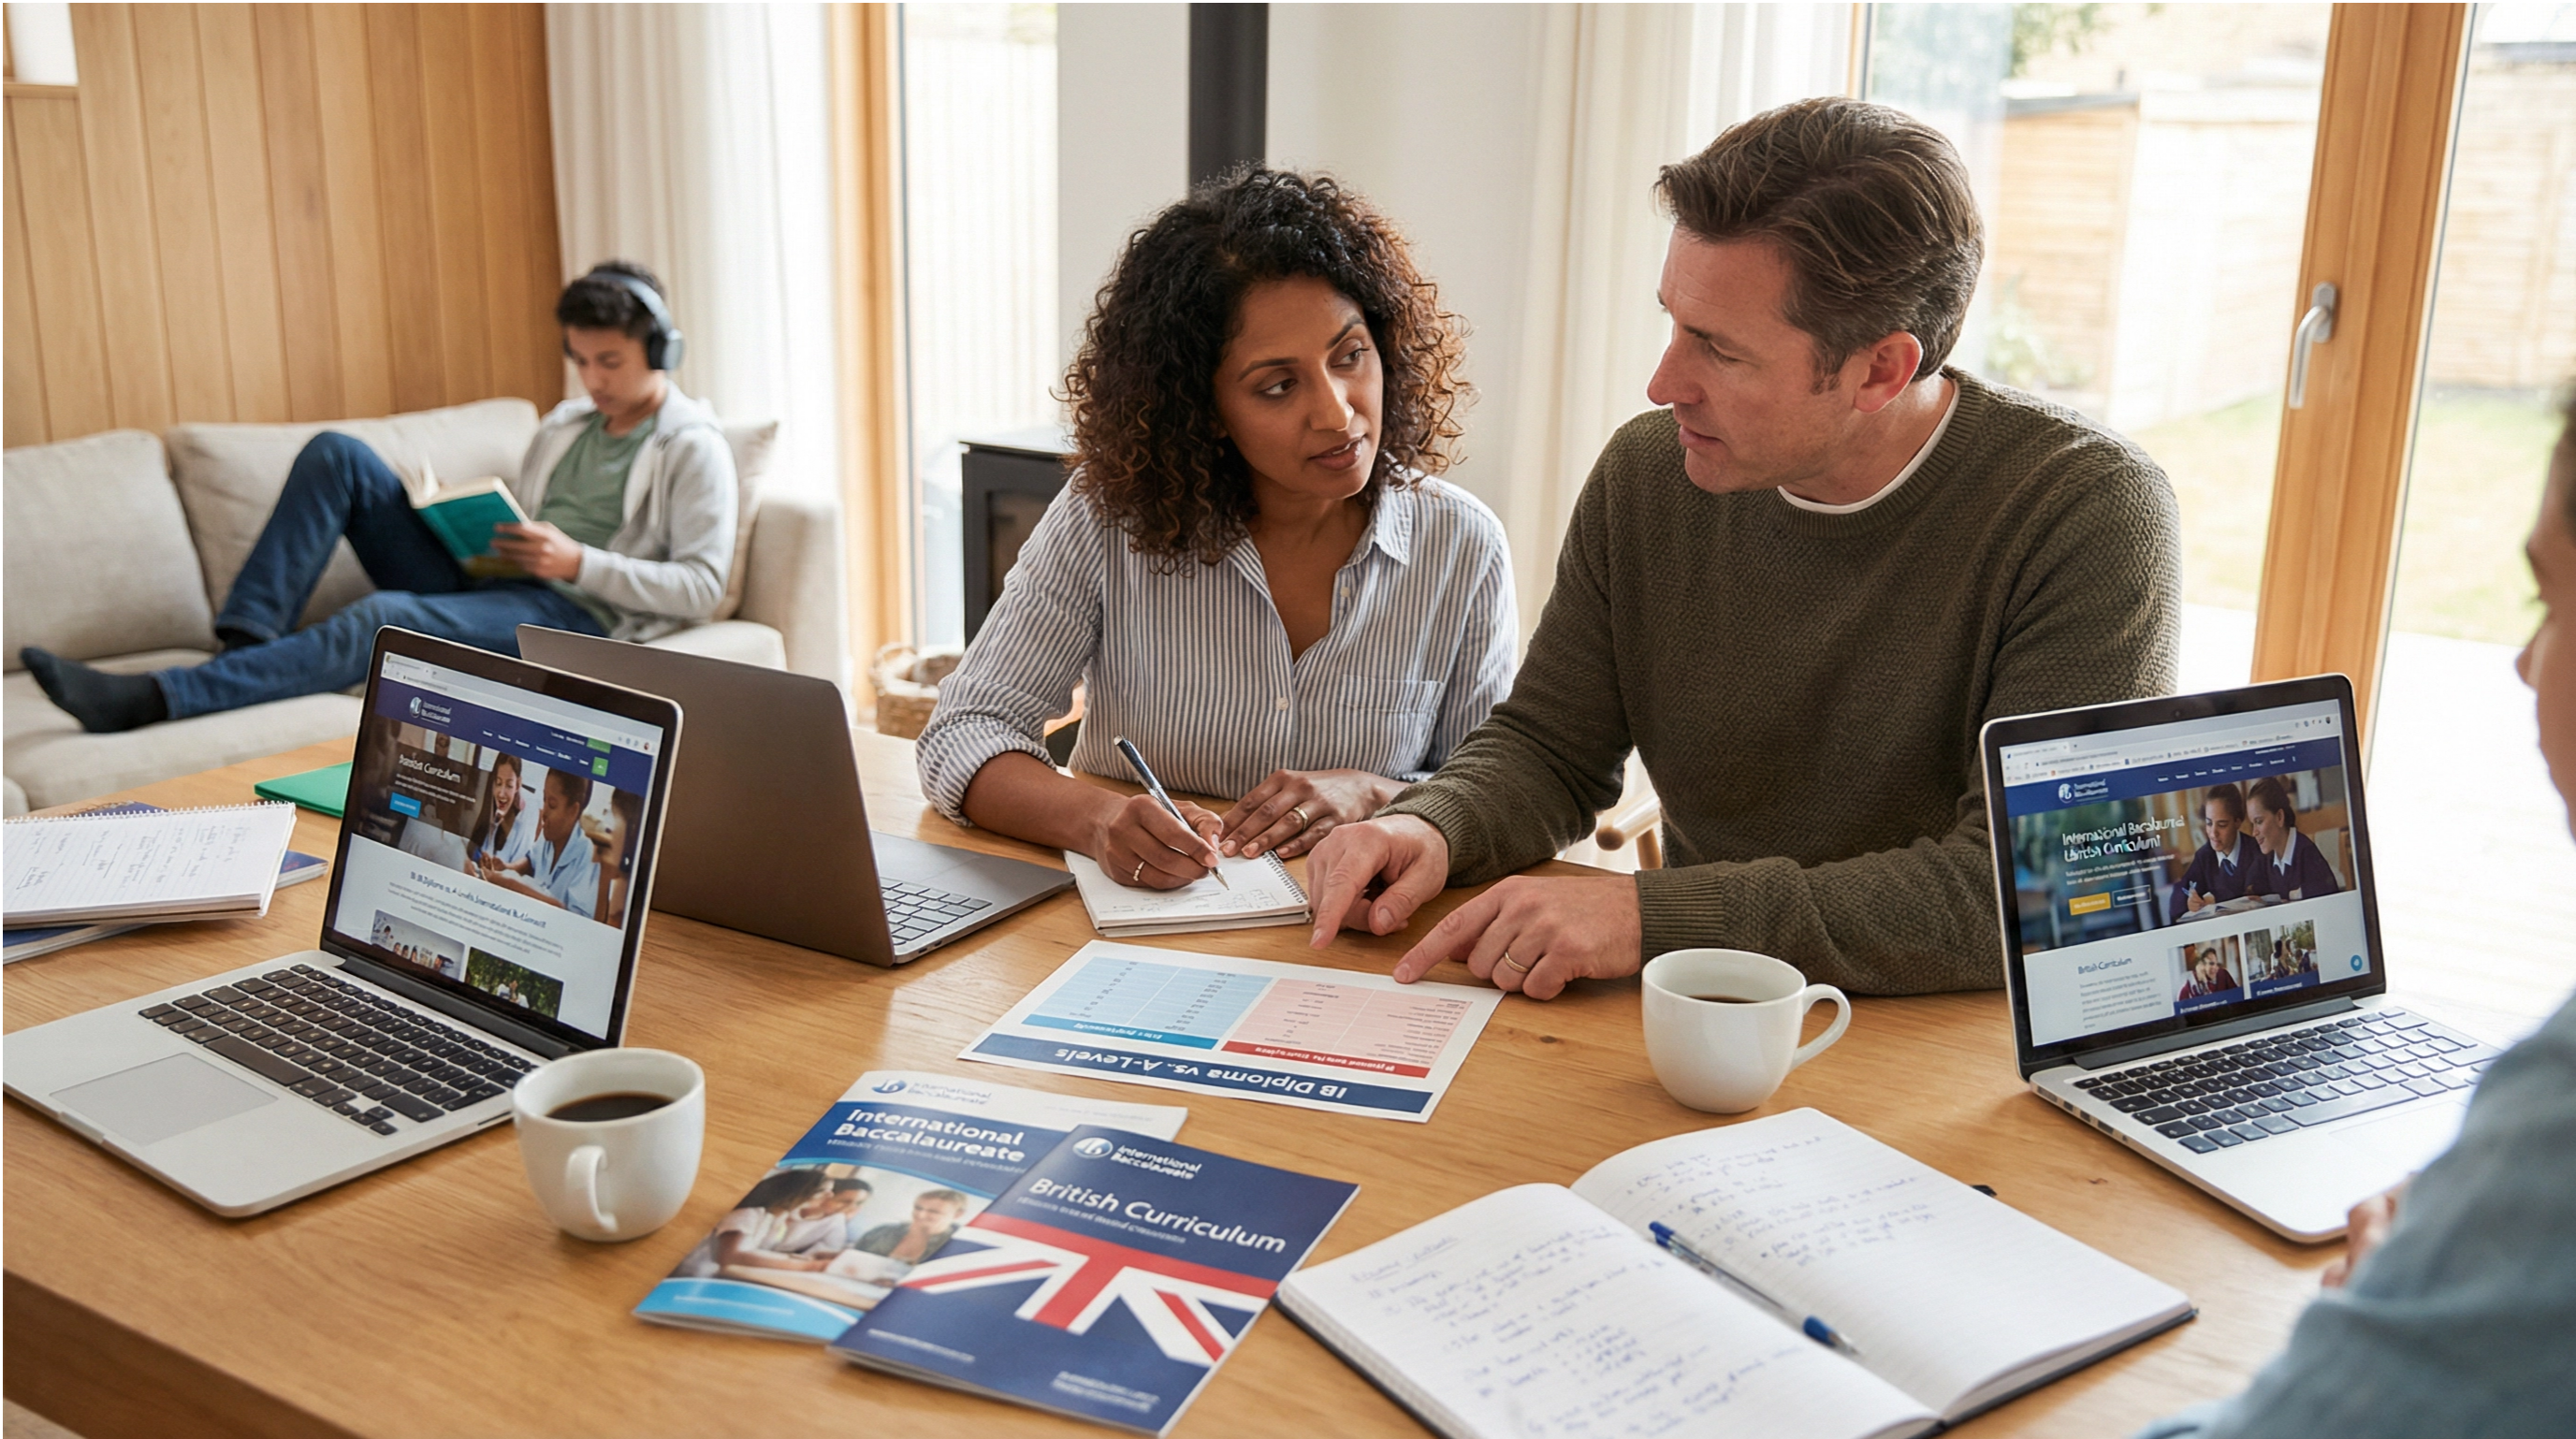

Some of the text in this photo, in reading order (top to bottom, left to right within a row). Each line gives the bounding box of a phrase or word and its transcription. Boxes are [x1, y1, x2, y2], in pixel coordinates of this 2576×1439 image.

[1055, 1048, 1163, 1071] A-Levels
[1319, 1084, 1347, 1099] IB
[834, 1123, 1026, 1162] Baccalaureate
[847, 1109, 1025, 1146] International
[1117, 1144, 1202, 1173] International
[1029, 1178, 1119, 1213] British
[1124, 1200, 1287, 1254] Curriculum
